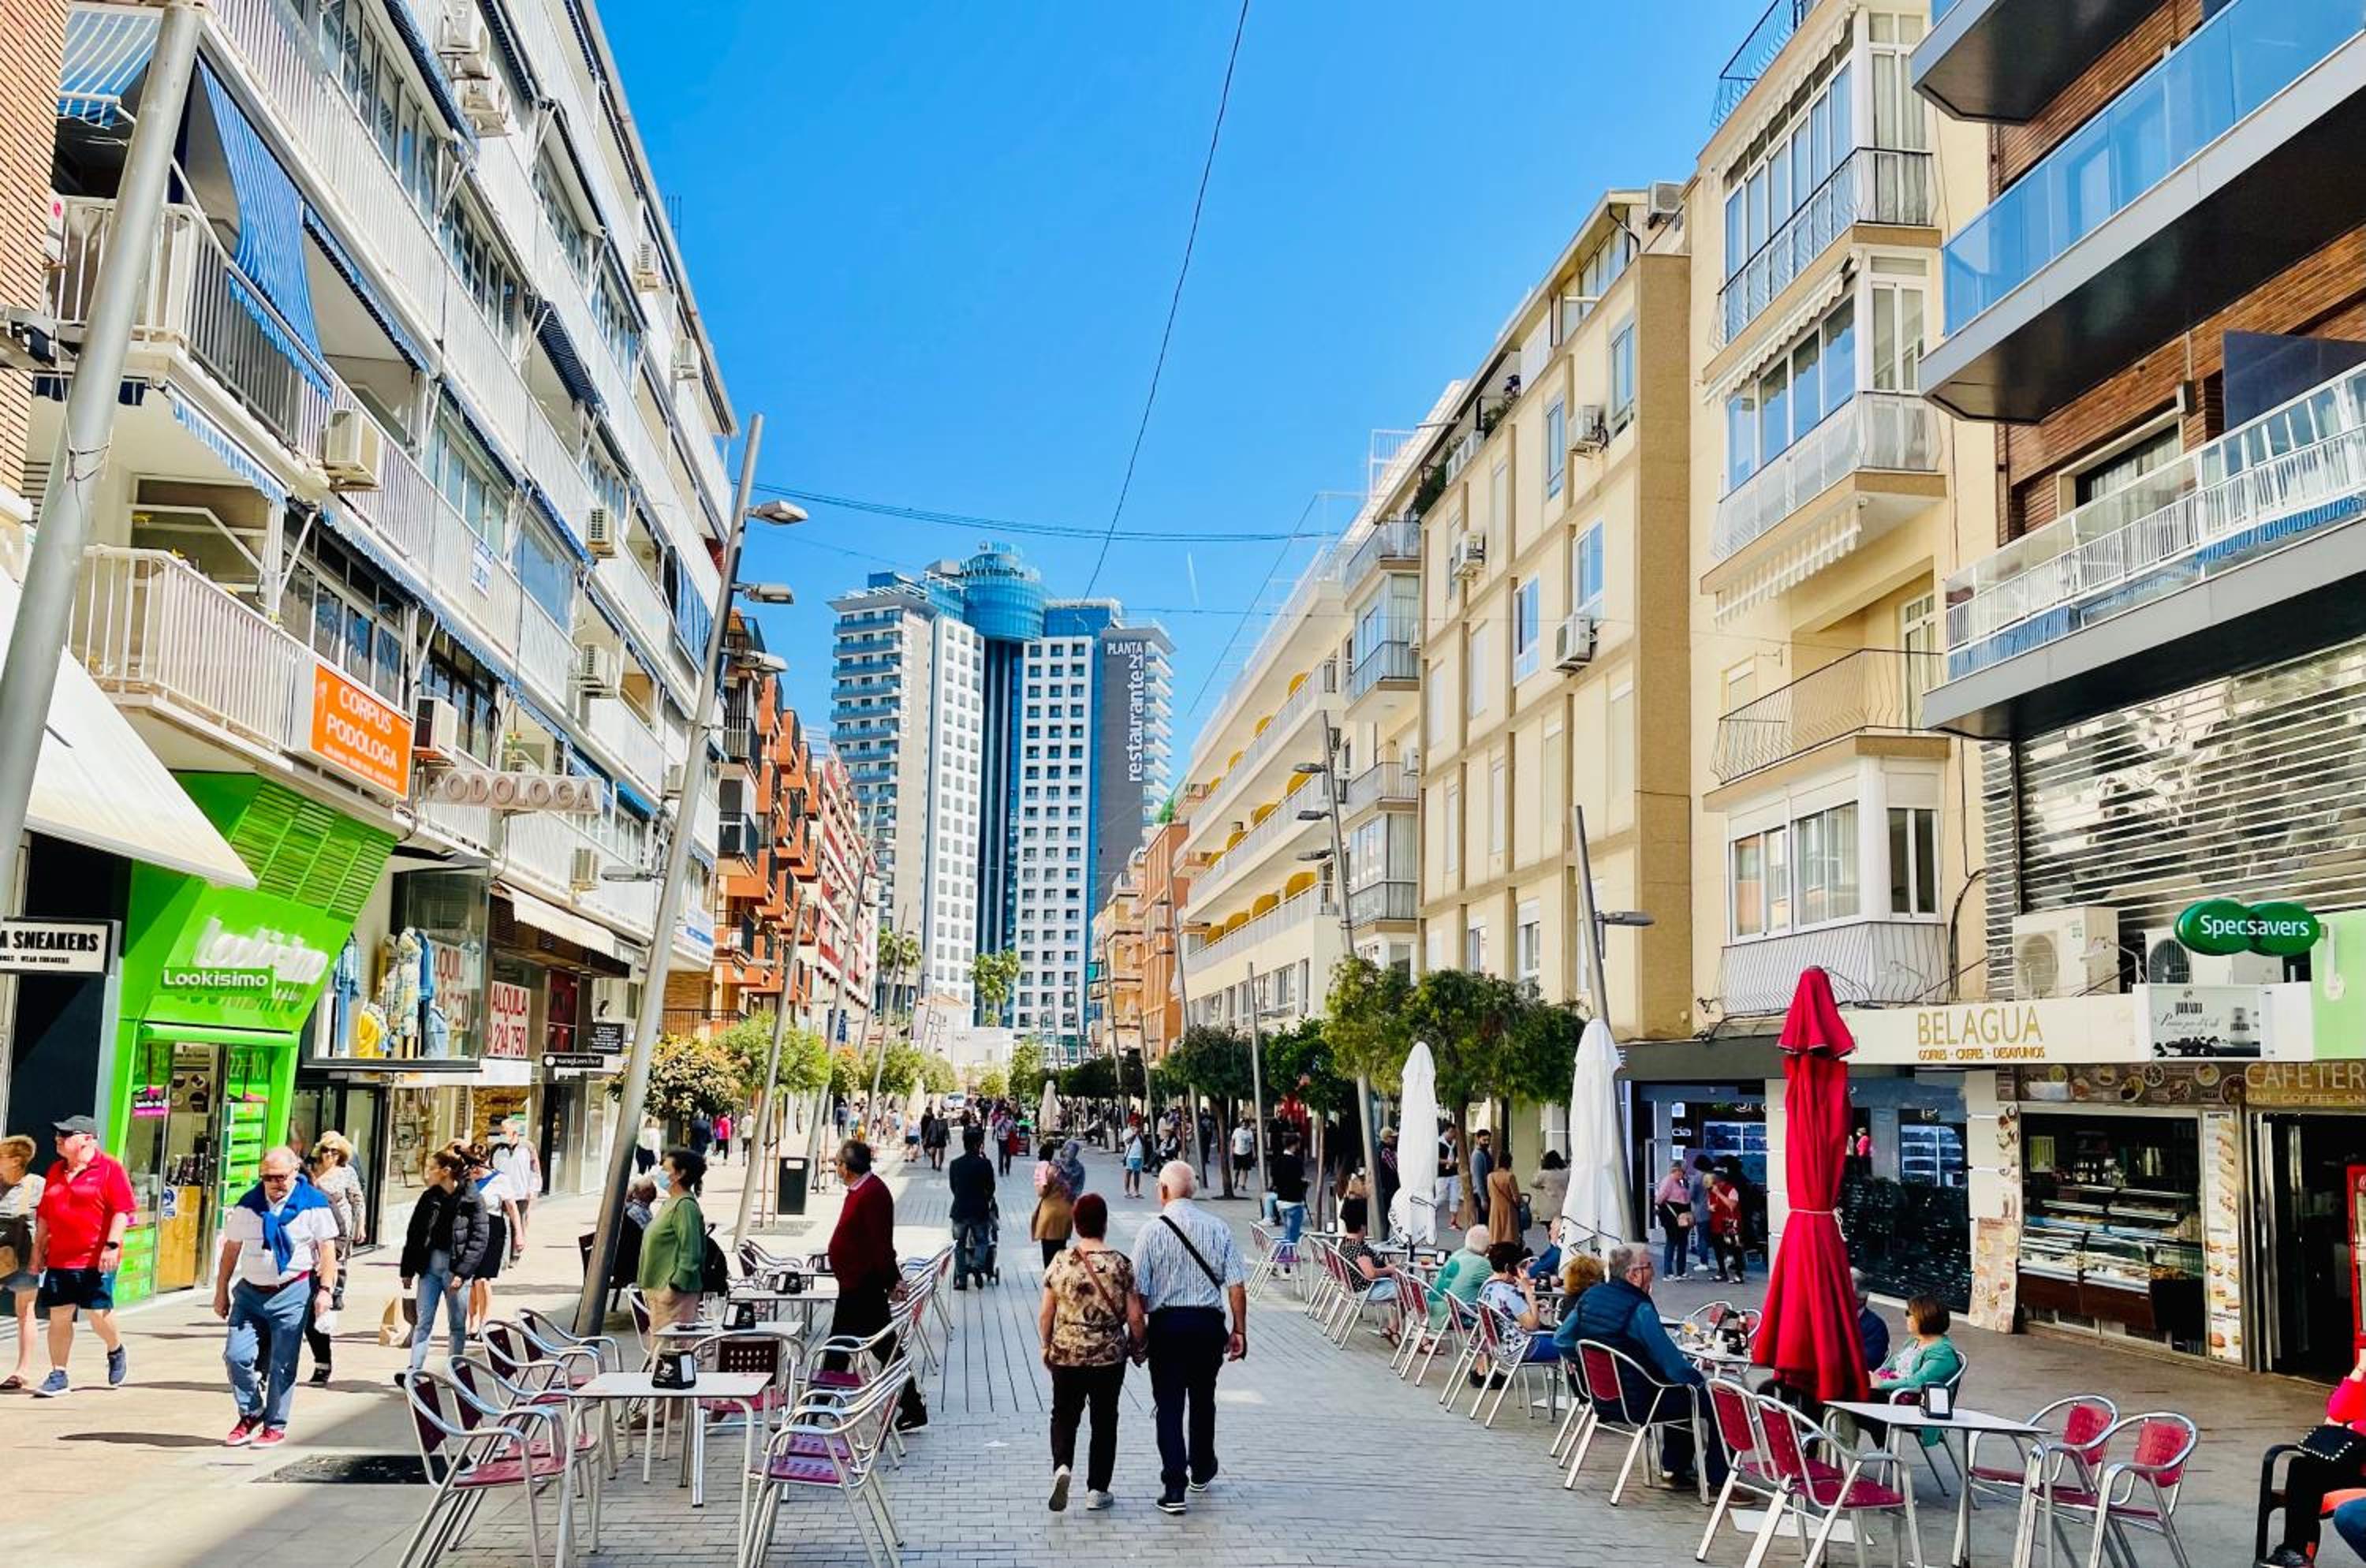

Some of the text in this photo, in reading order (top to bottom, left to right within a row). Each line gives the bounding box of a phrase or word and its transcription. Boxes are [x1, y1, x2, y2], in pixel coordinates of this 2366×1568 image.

[1106, 641, 1144, 655] PLANTA
[338, 685, 393, 735] CORPUS
[1126, 671, 1144, 782] restaurante
[326, 713, 398, 771] PODÓLOGA
[2200, 914, 2310, 939] Specsavers
[13, 931, 99, 952] SNEAKERS
[162, 969, 269, 987] Lookisimo
[491, 984, 527, 1022] ALQUILA
[1993, 1046, 2045, 1059] DESAYUNOS
